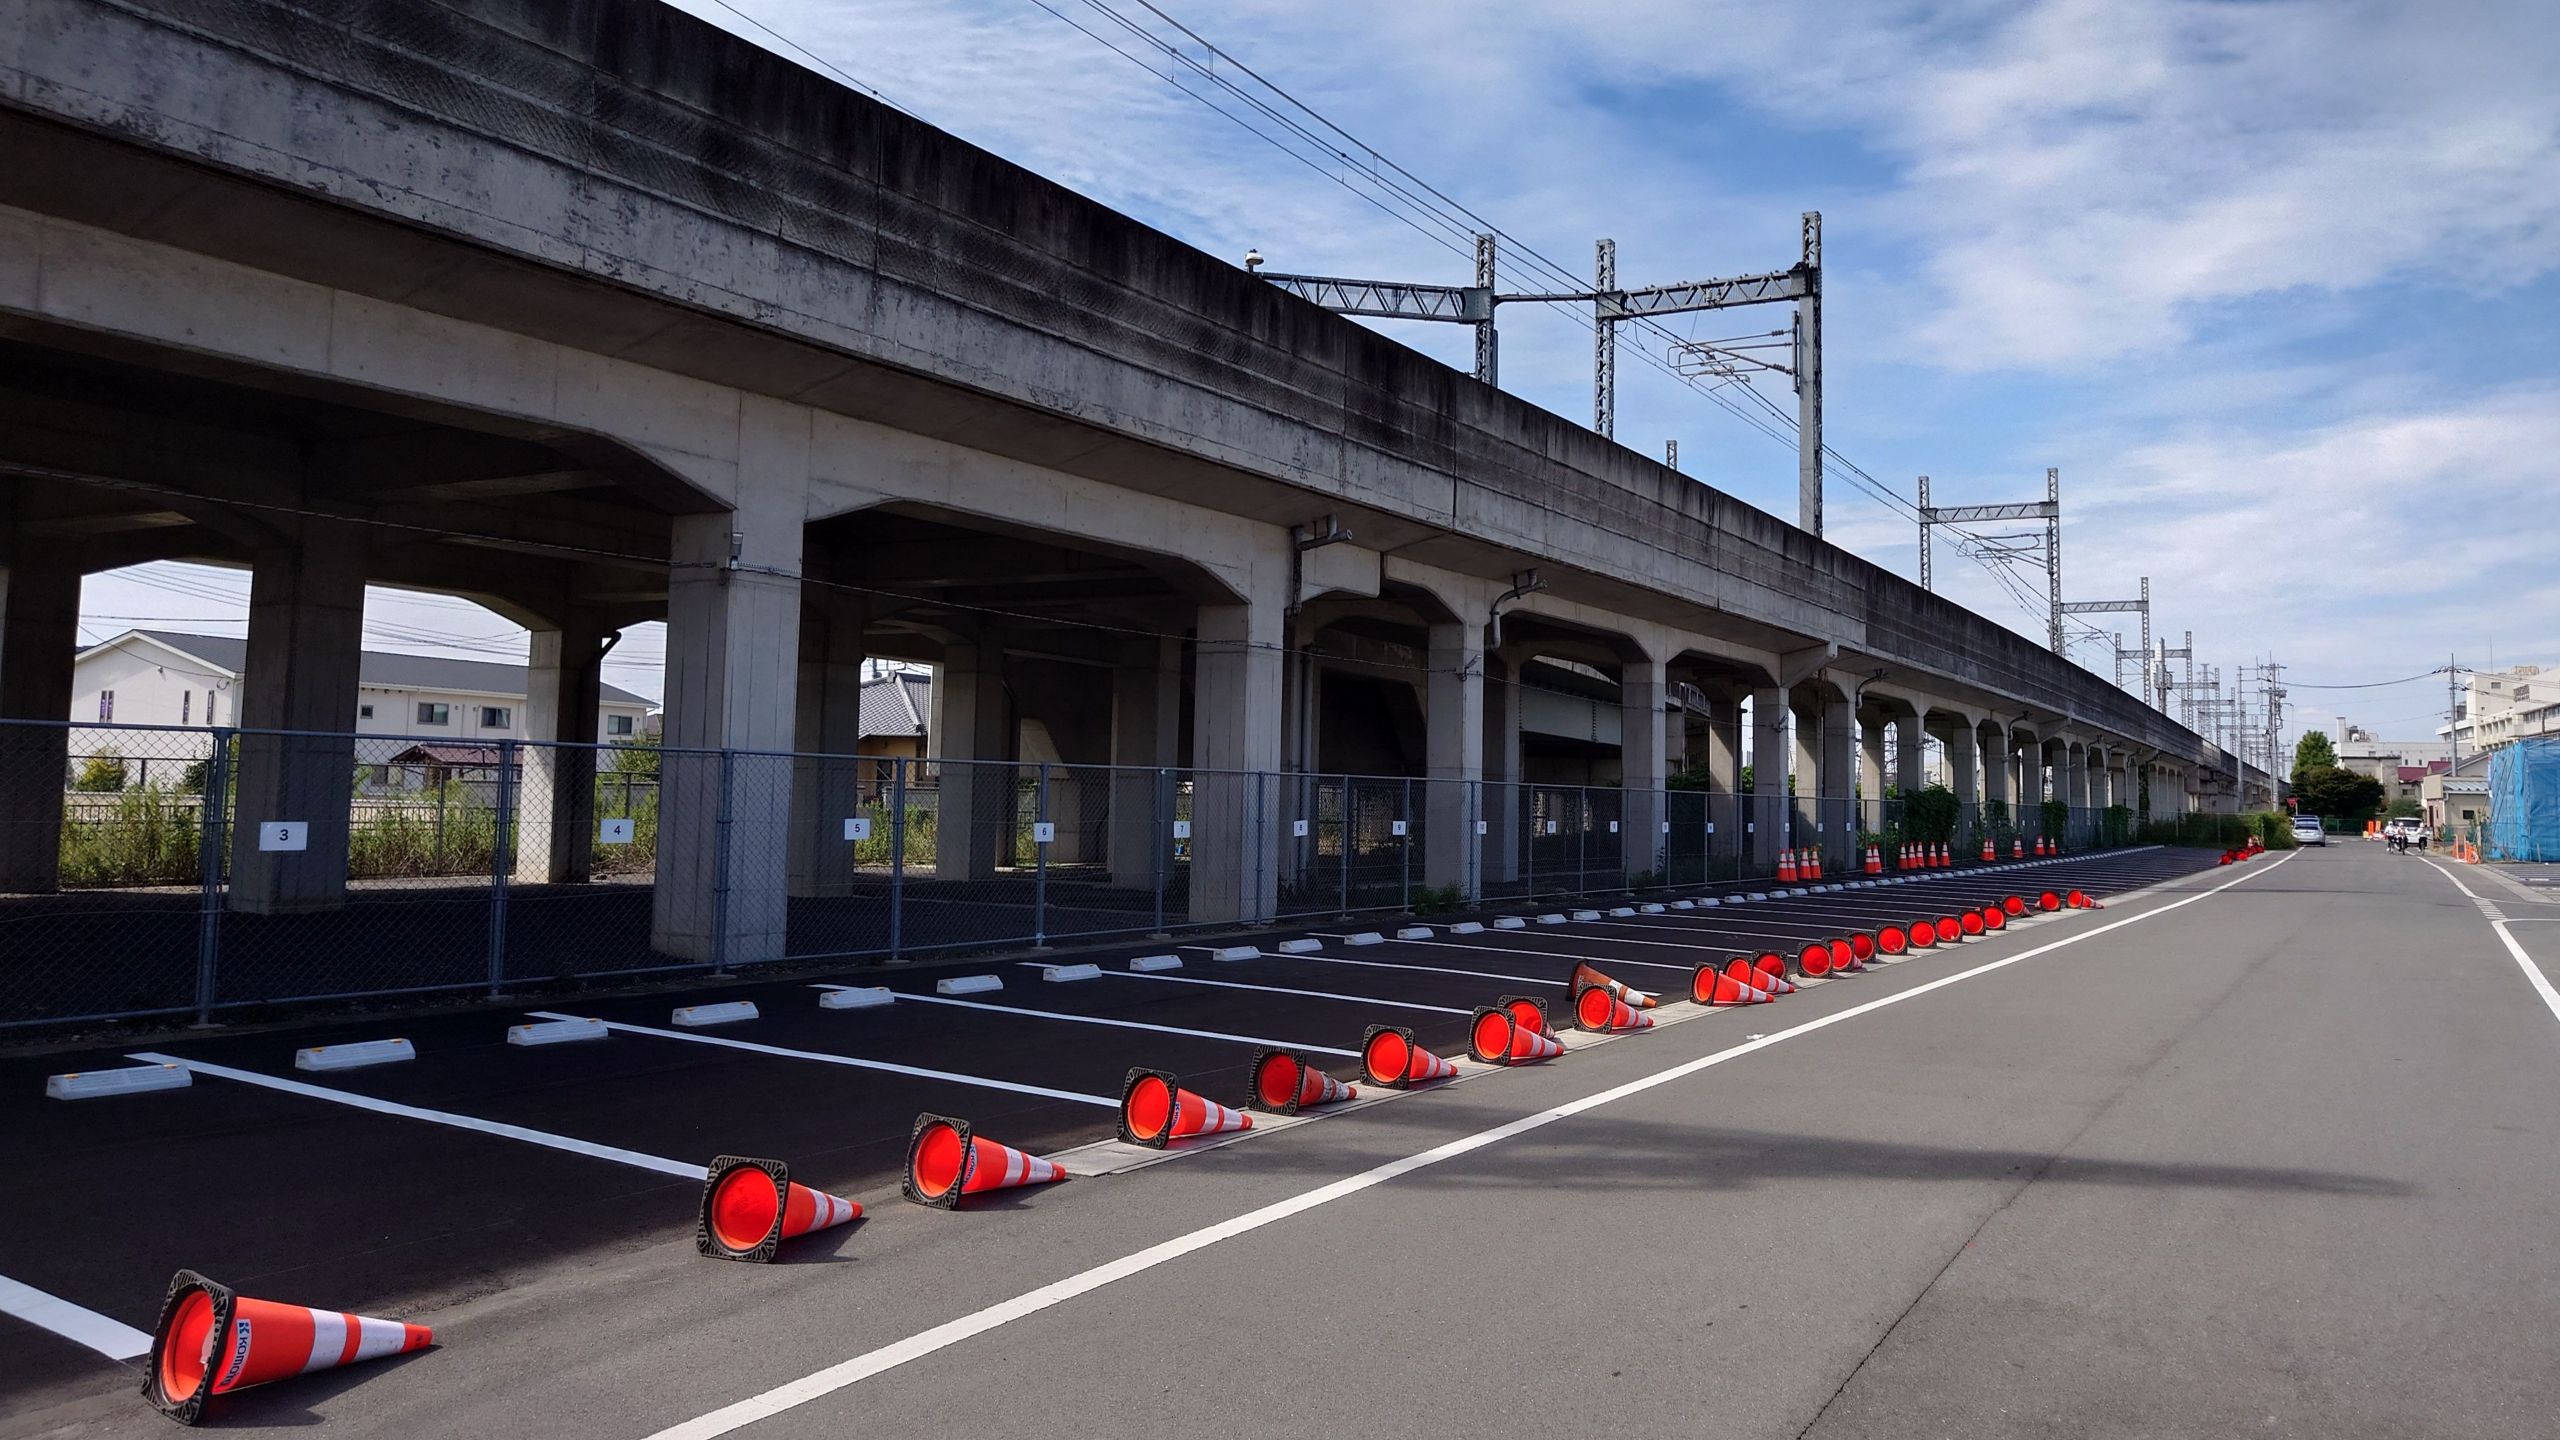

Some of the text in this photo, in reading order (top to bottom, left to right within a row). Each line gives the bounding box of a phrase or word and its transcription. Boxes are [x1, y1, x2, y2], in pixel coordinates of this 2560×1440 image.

[614, 825, 622, 836] 4
[855, 824, 861, 833] 5
[1042, 827, 1047, 836] 6
[1180, 825, 1184, 833] 7
[279, 829, 289, 841] 3
